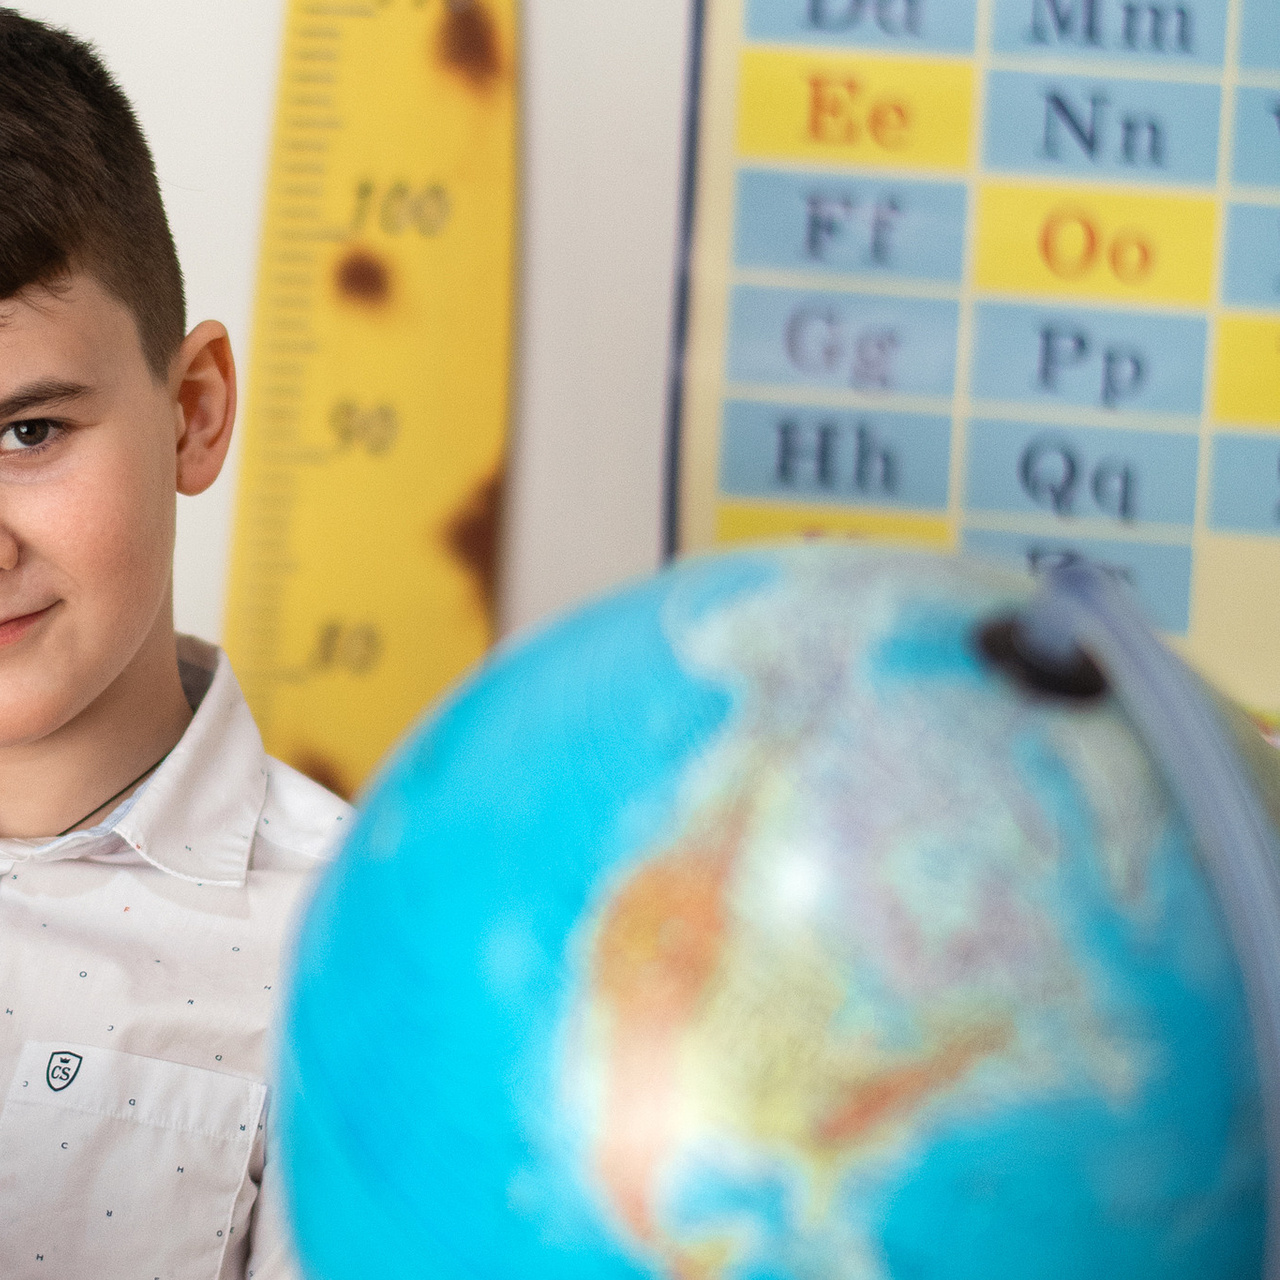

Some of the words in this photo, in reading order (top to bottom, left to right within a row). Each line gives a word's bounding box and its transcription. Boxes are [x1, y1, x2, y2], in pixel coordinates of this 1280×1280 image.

[804, 70, 916, 151] Ee
[1040, 82, 1166, 169] Nn
[349, 178, 454, 239] 100
[802, 188, 905, 269] Ff
[1038, 199, 1155, 286] Oo
[780, 302, 903, 396] Gg
[1035, 322, 1148, 410] Pp
[772, 417, 900, 498] Hh
[1017, 431, 1142, 525] Qq
[51, 1065, 71, 1081] CS
